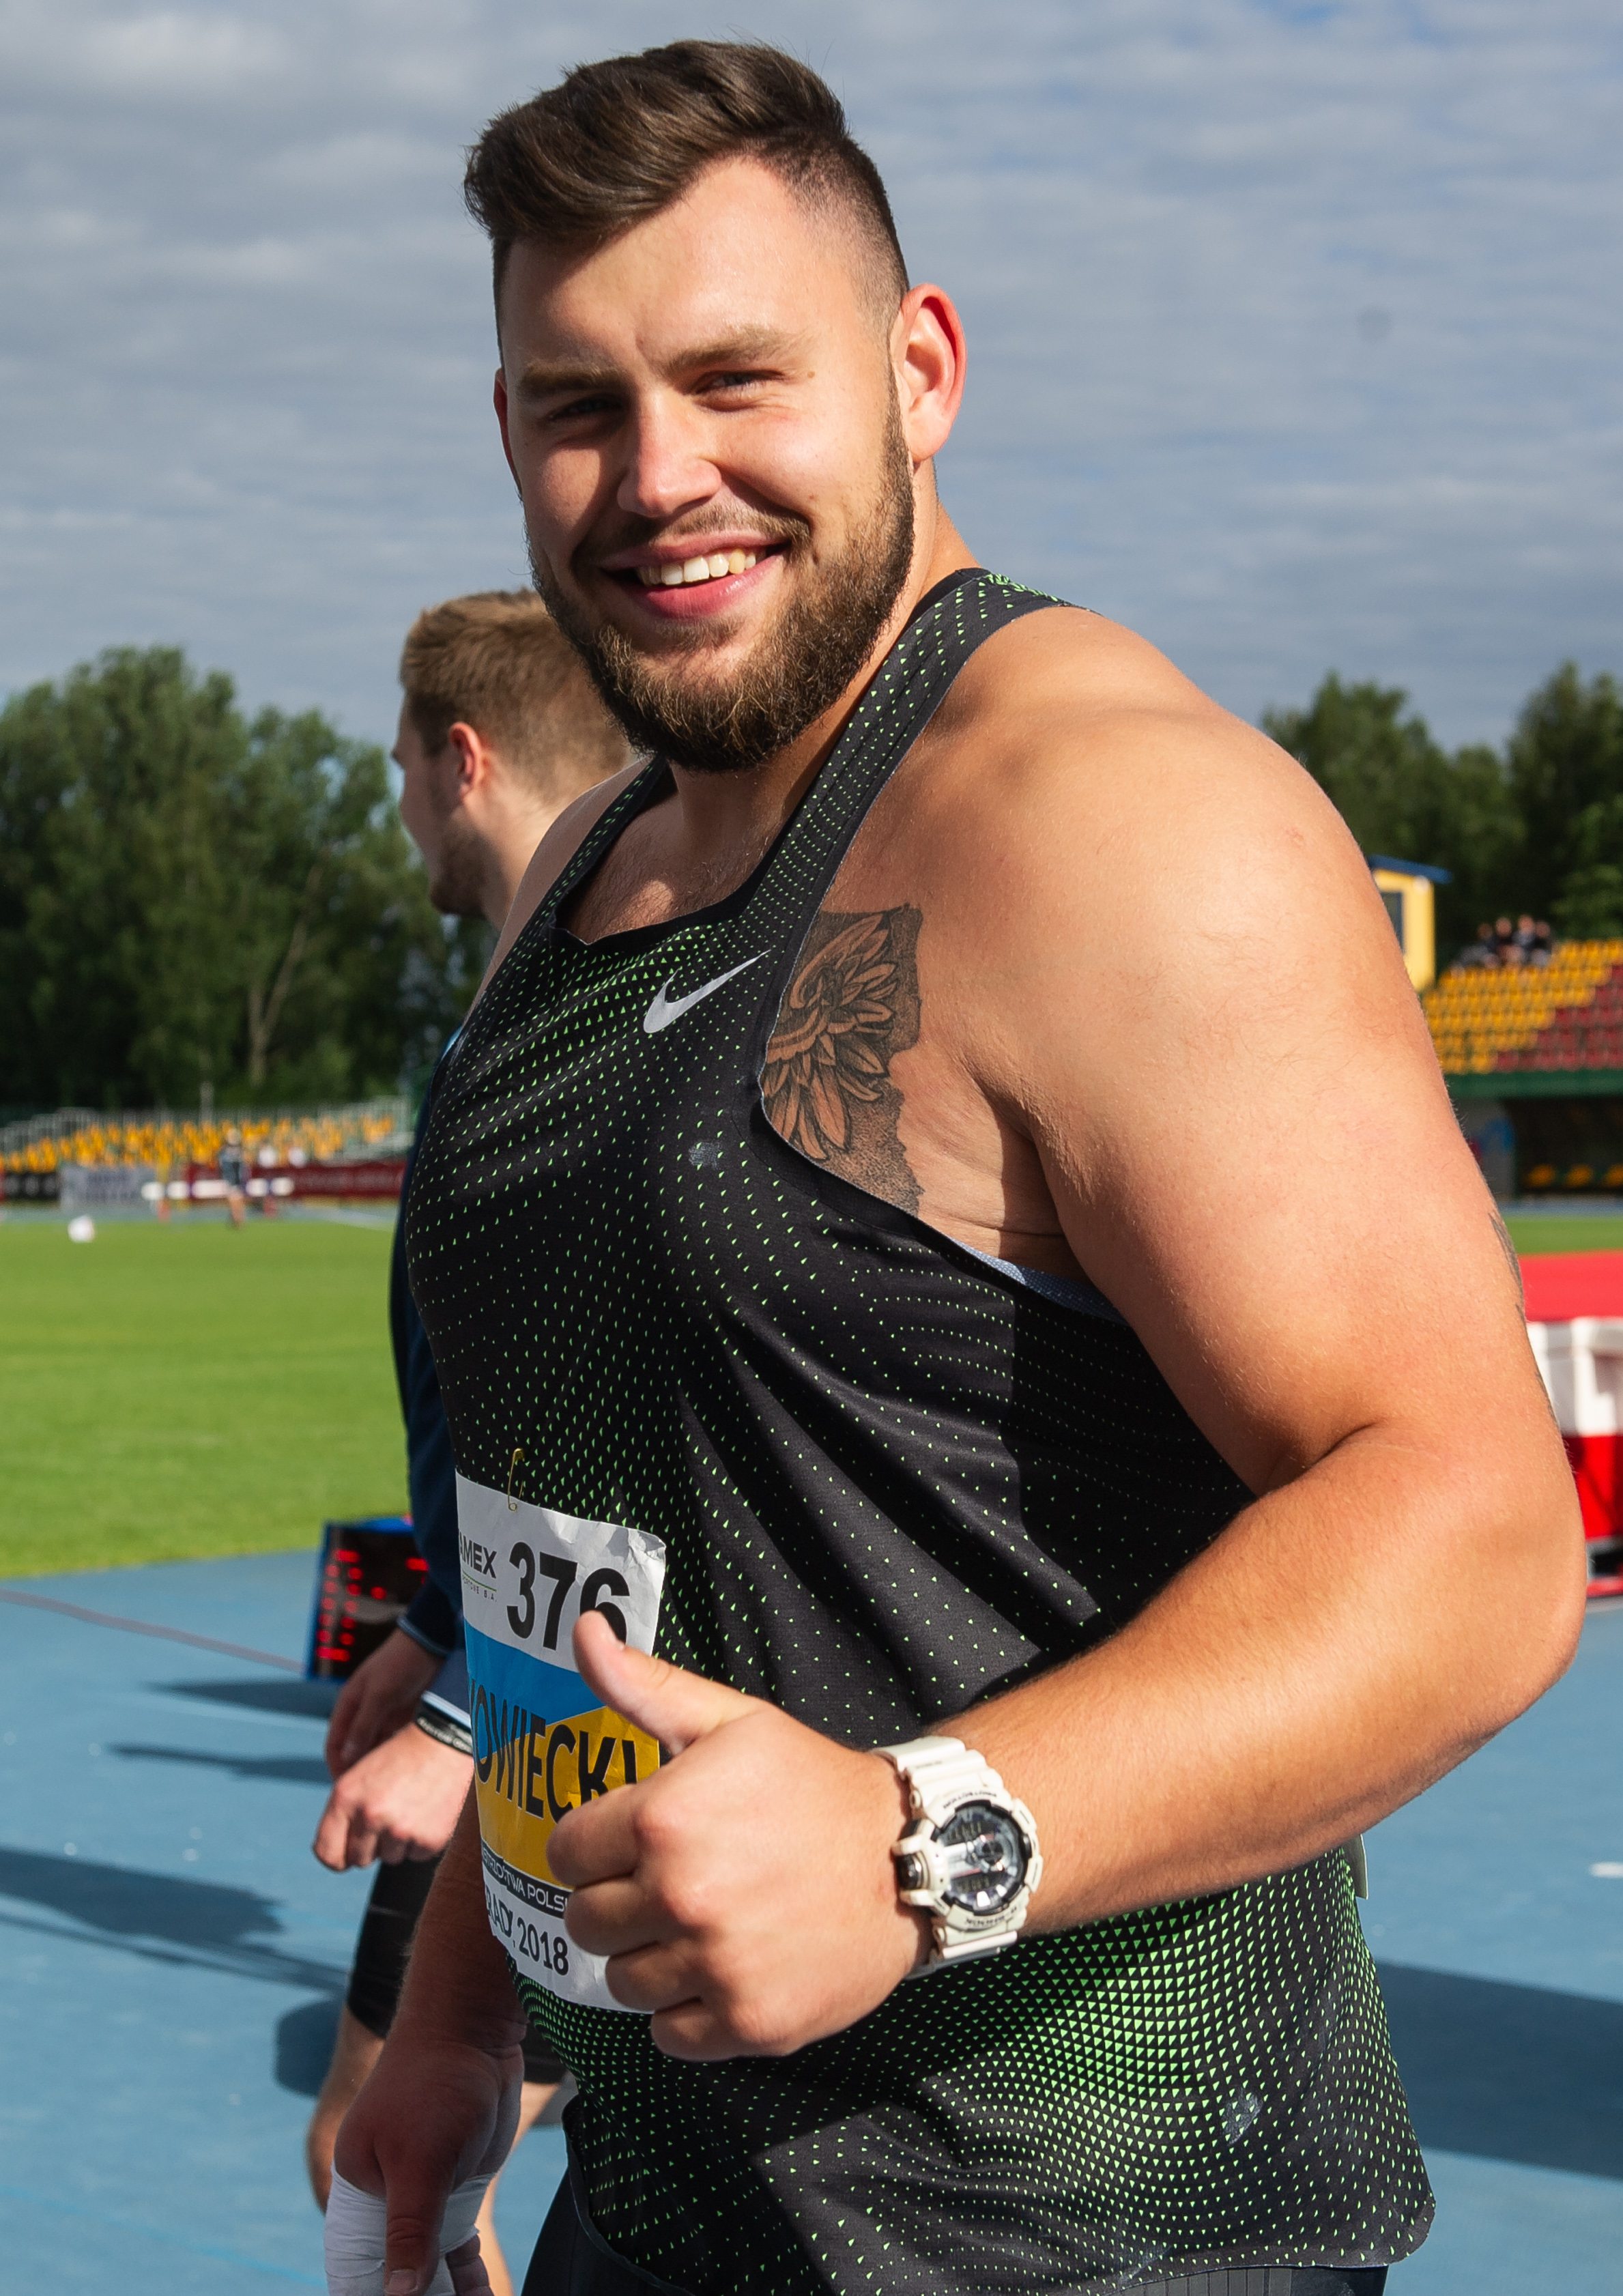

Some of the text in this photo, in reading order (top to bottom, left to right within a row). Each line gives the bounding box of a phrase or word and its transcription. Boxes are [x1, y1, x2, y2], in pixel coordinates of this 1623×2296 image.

[506, 1542, 631, 1651] 376
[471, 1679, 638, 1824] OWIECK
[528, 1886, 568, 1912] POLS
[517, 1917, 569, 1976] 2018
